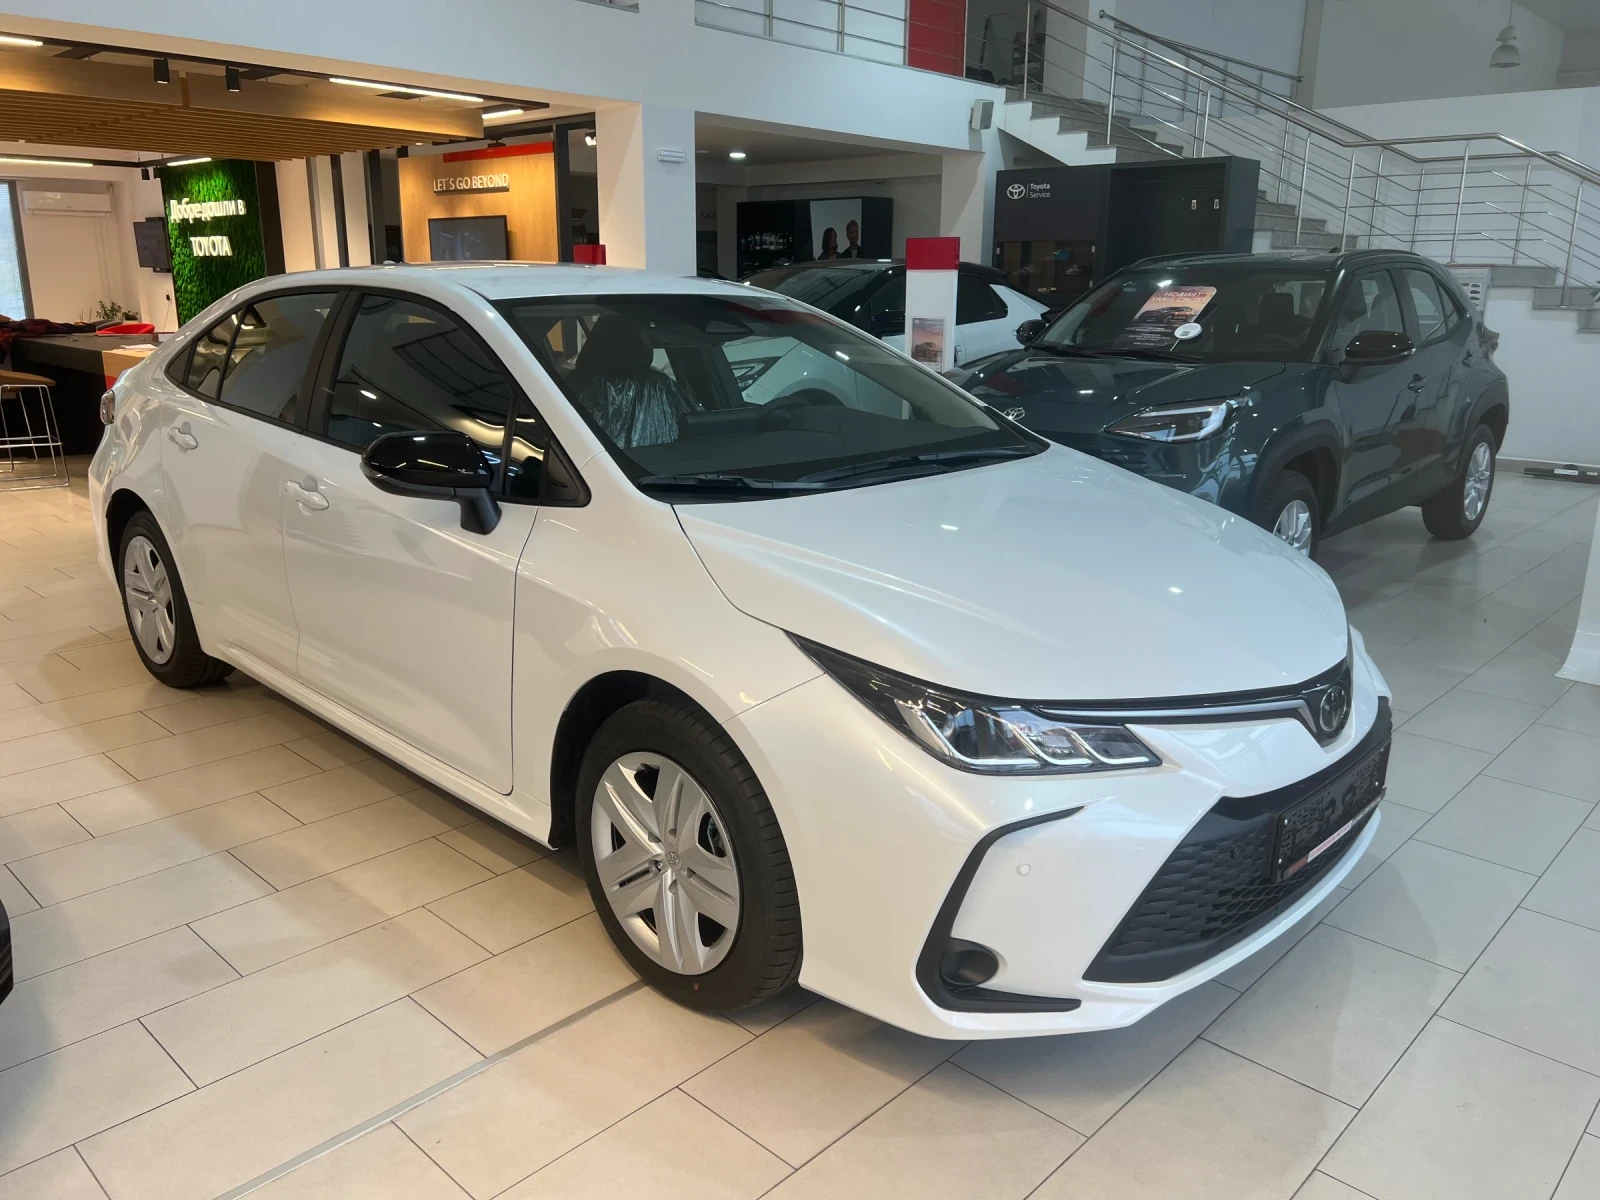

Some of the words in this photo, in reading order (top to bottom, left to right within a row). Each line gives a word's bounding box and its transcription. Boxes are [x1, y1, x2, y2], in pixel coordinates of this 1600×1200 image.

[456, 176, 471, 190] GO
[472, 173, 509, 189] BEYOND
[1030, 183, 1050, 191] Toyota
[170, 198, 236, 223] Добредошли
[190, 236, 233, 256] TOYOTA
